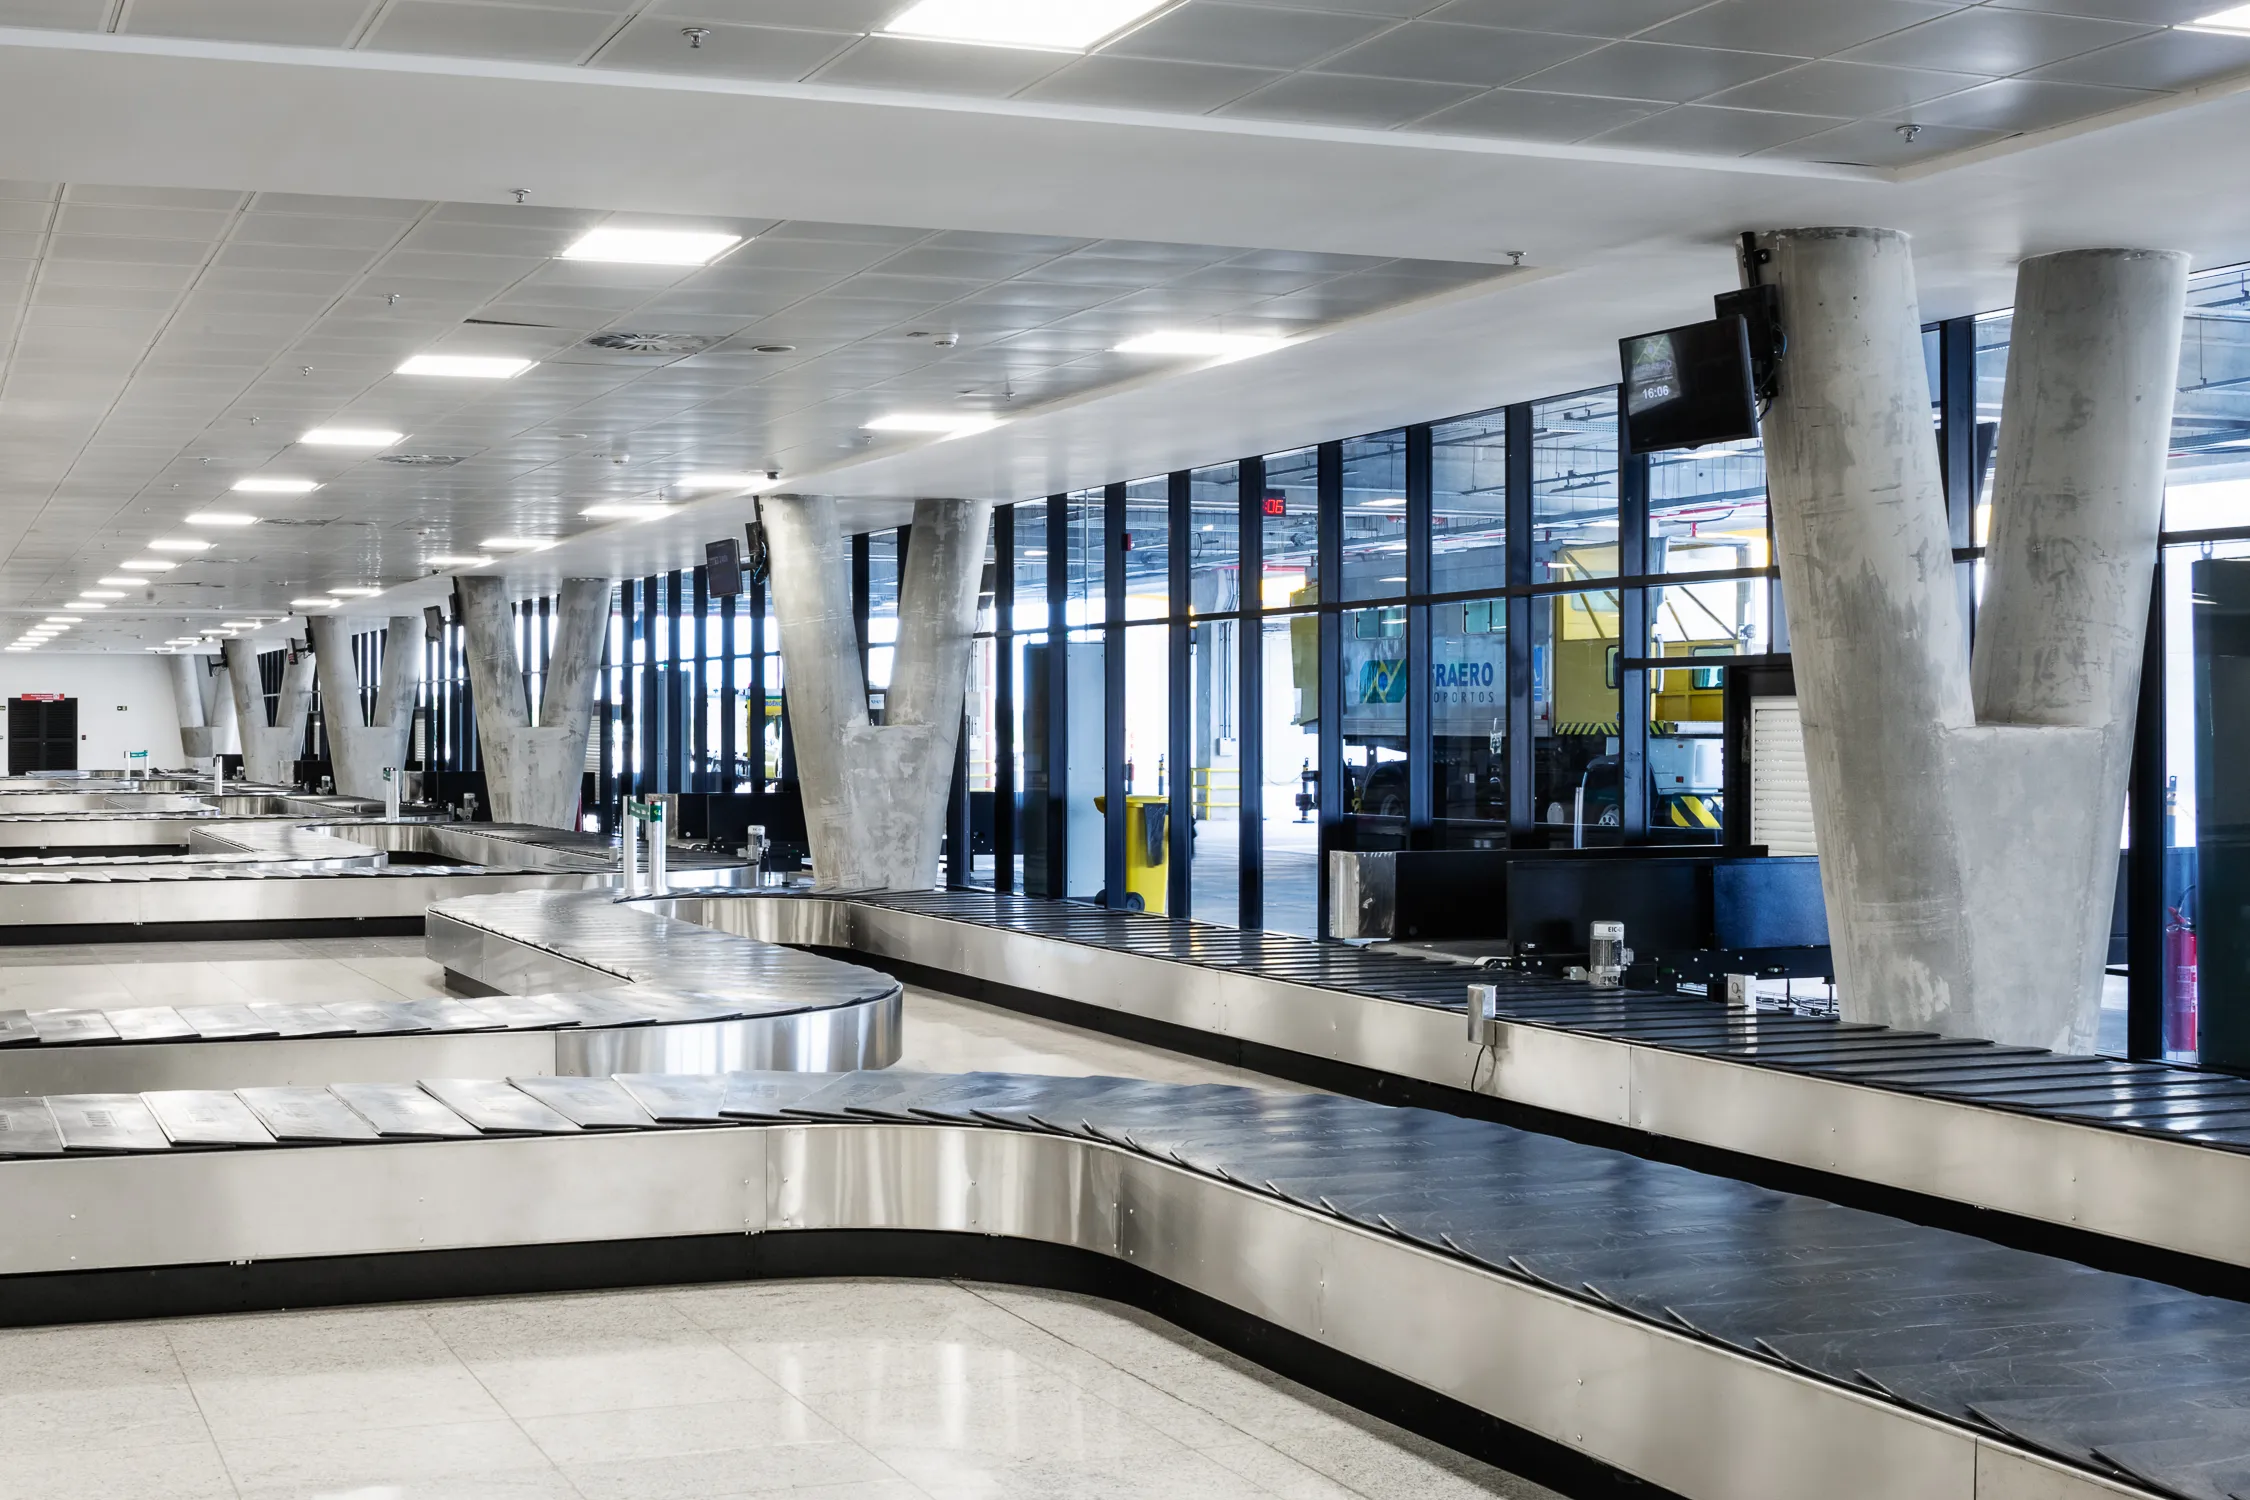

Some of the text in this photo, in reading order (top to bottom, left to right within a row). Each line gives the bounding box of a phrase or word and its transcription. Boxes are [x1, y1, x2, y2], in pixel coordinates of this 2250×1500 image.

[1642, 385, 1669, 399] 16:06
[1433, 662, 1494, 687] RAERO
[1433, 691, 1494, 703] OPORTOS
